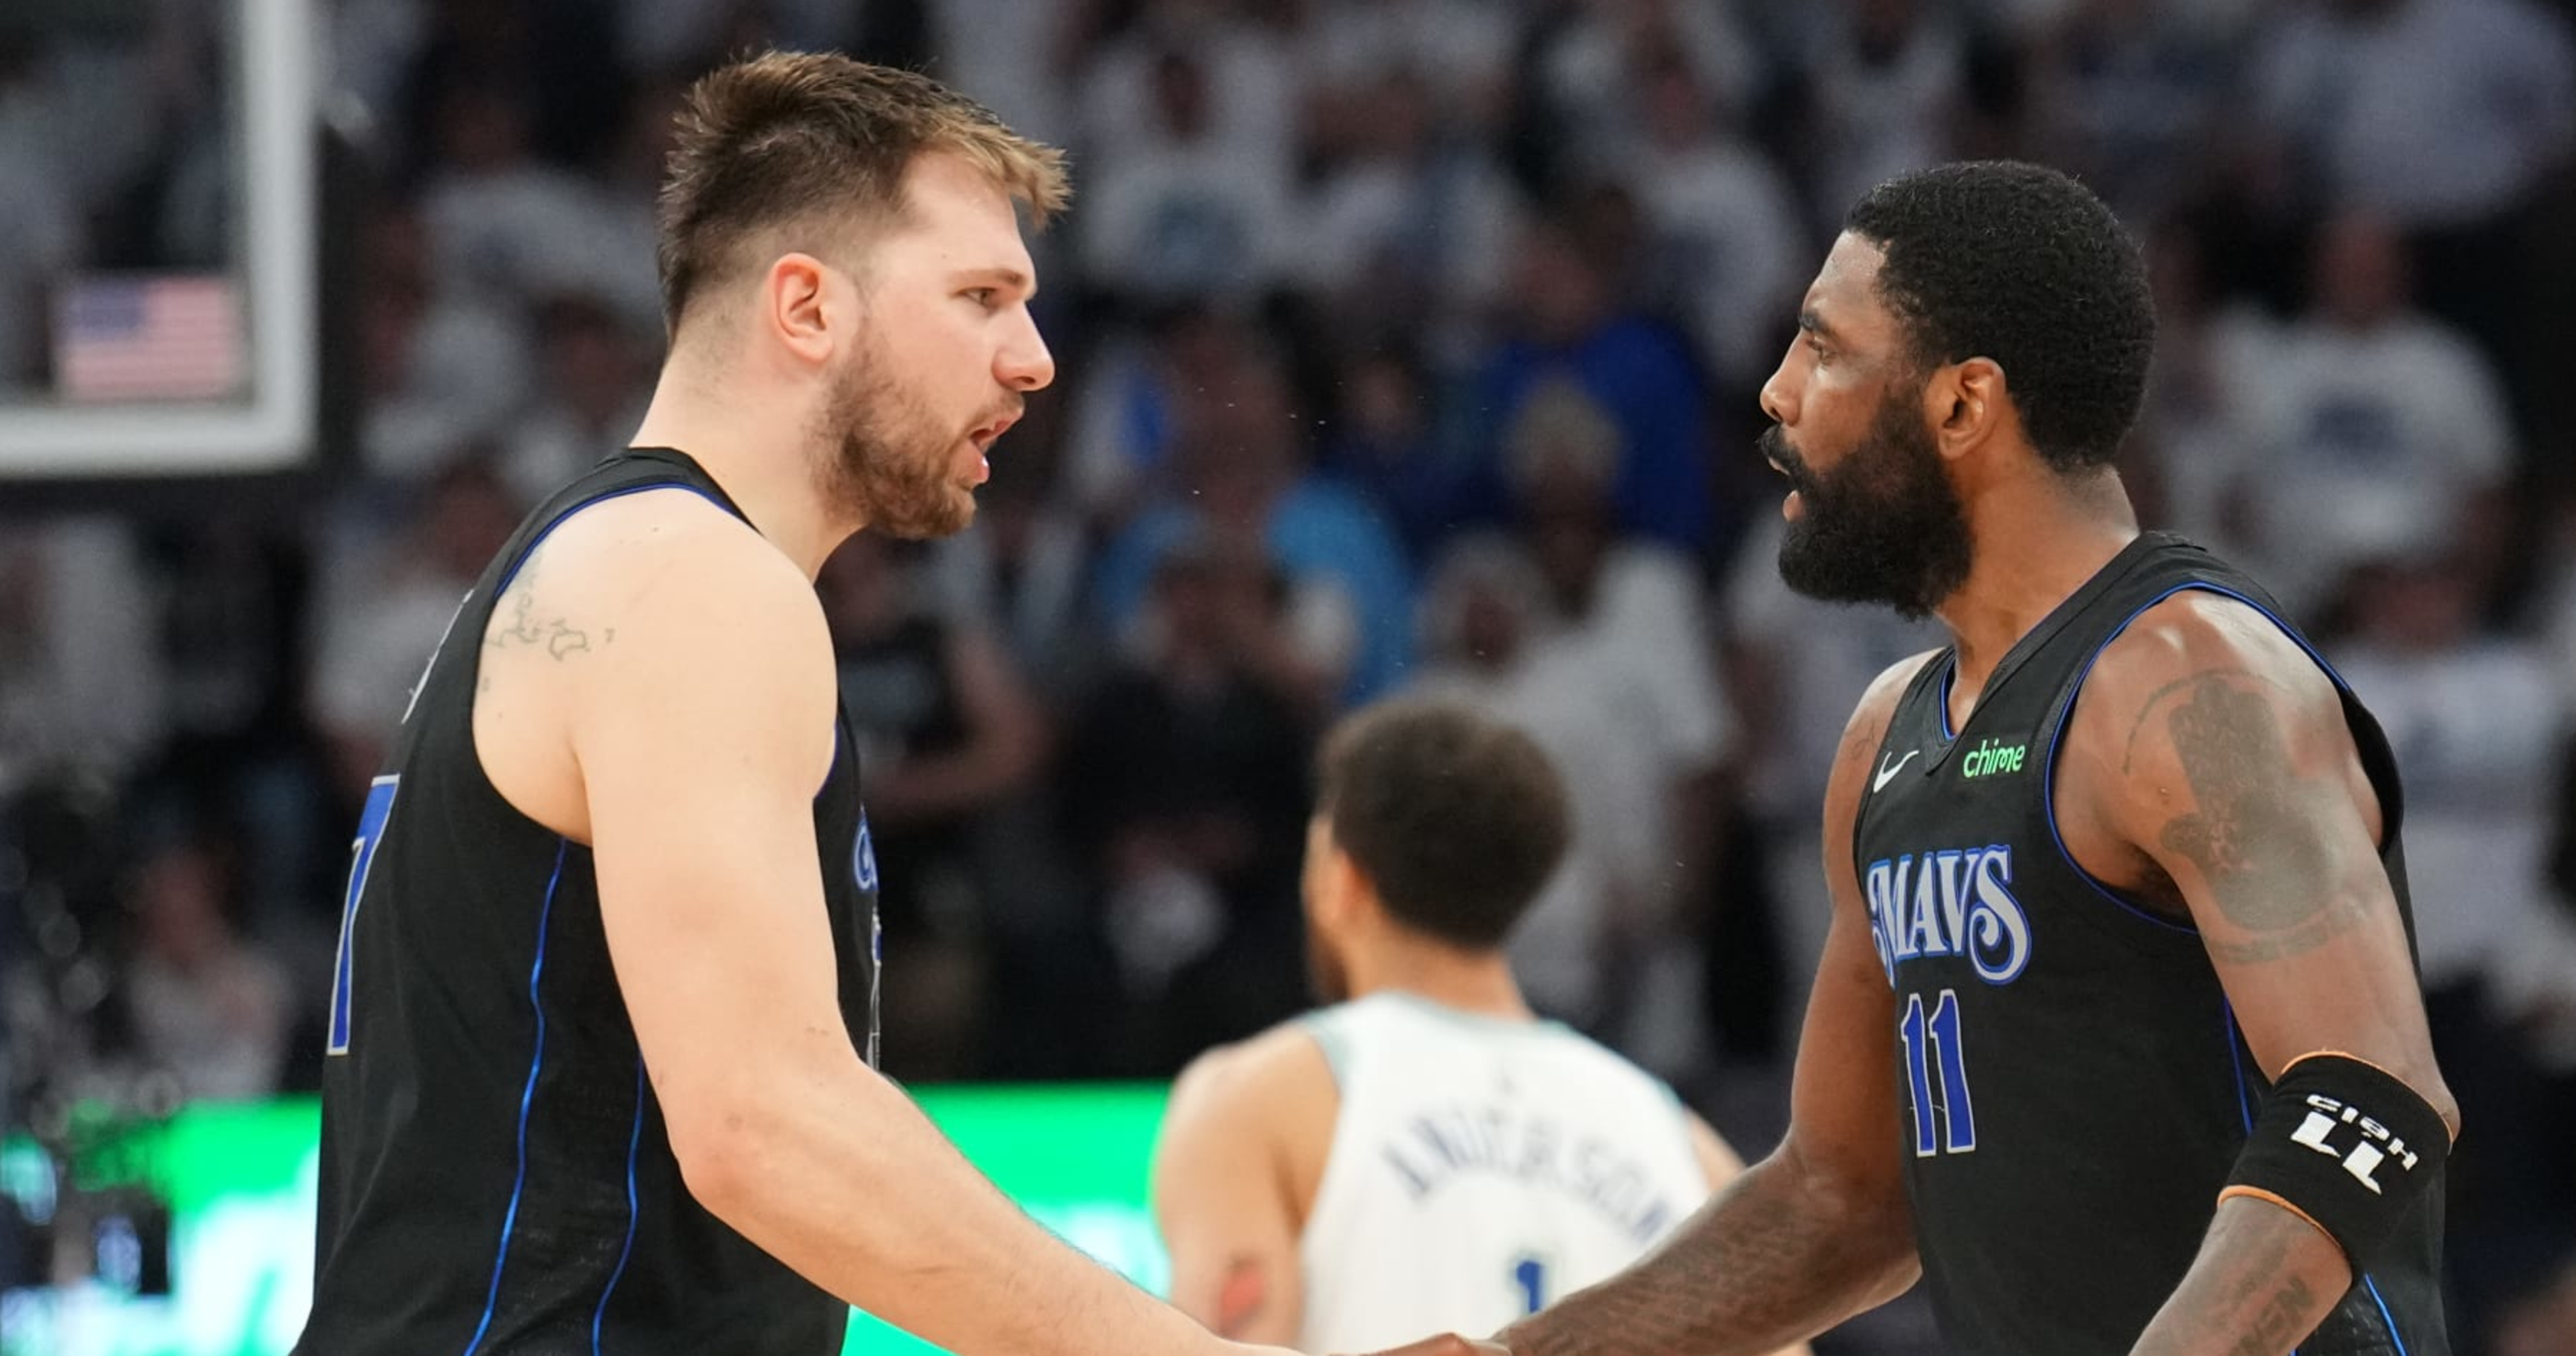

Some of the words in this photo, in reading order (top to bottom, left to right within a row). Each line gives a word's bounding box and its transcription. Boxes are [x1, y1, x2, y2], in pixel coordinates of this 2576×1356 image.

[1963, 738, 2026, 778] chime
[1868, 844, 2031, 989] MAVS
[1901, 989, 1975, 1157] 11
[2291, 1111, 2384, 1195] 11
[1510, 1256, 1546, 1315] 1
